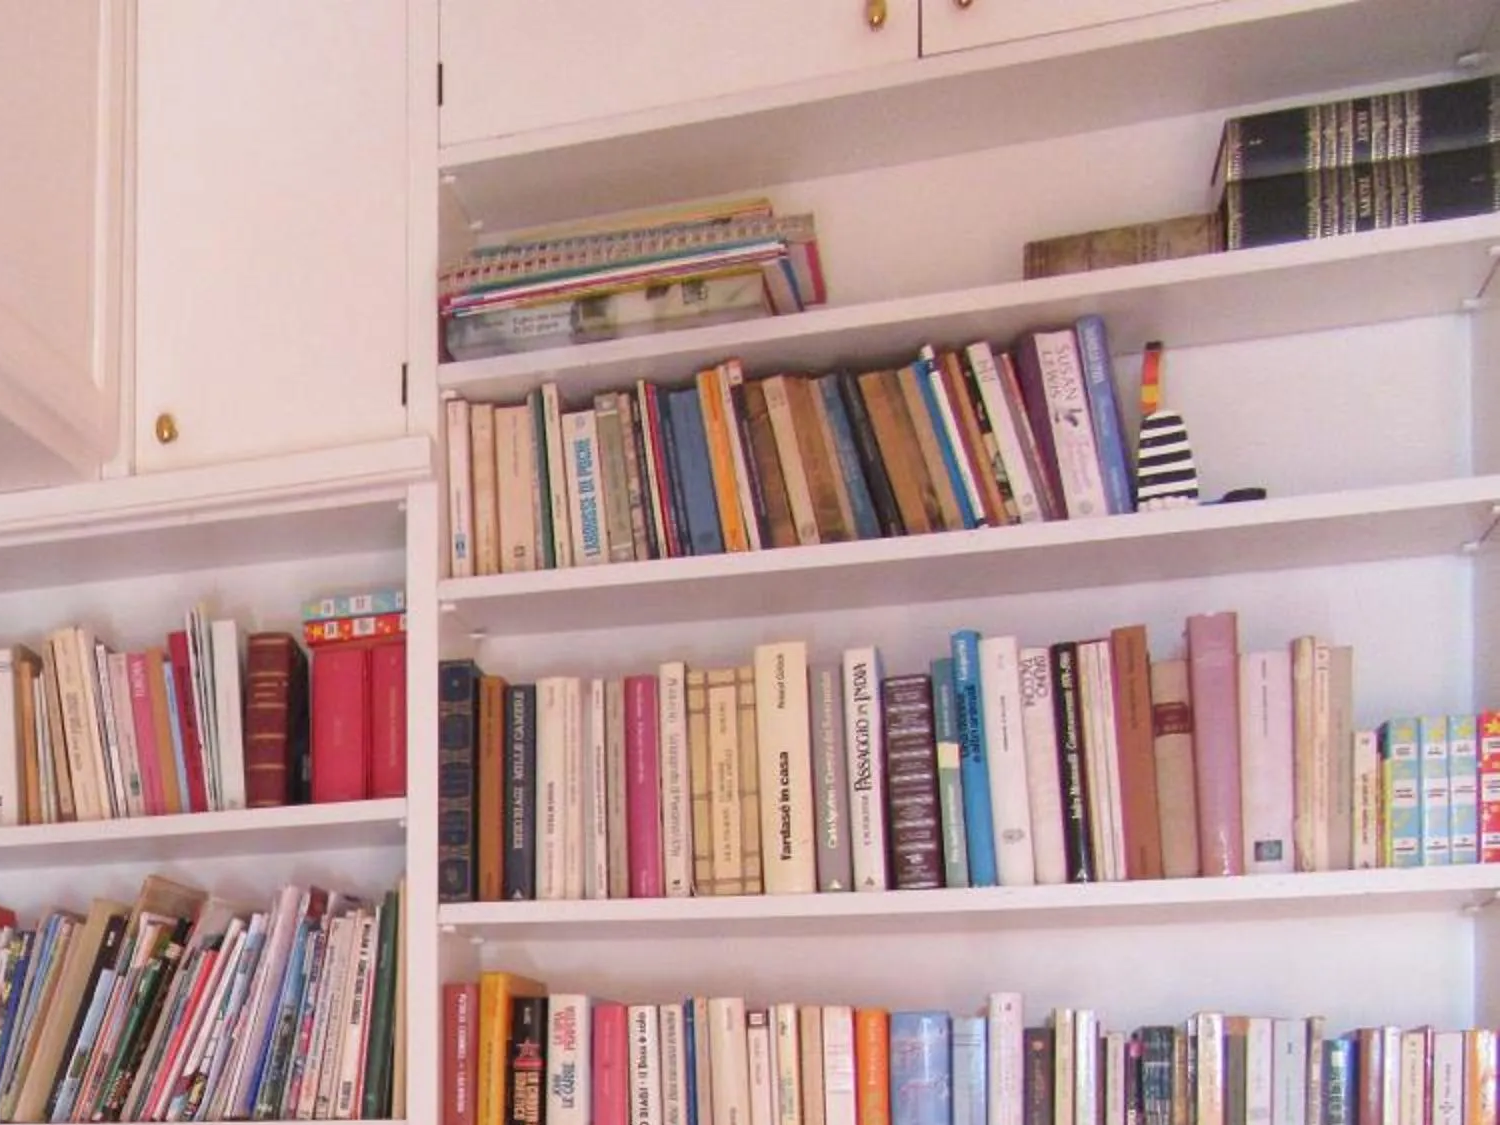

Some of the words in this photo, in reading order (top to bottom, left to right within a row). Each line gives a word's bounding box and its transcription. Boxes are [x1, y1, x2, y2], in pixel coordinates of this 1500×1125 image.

[853, 663, 871, 702] INDIA
[780, 751, 790, 786] casa
[854, 720, 872, 792] PASSAGGIO
[638, 1087, 649, 1118] BIAGI
